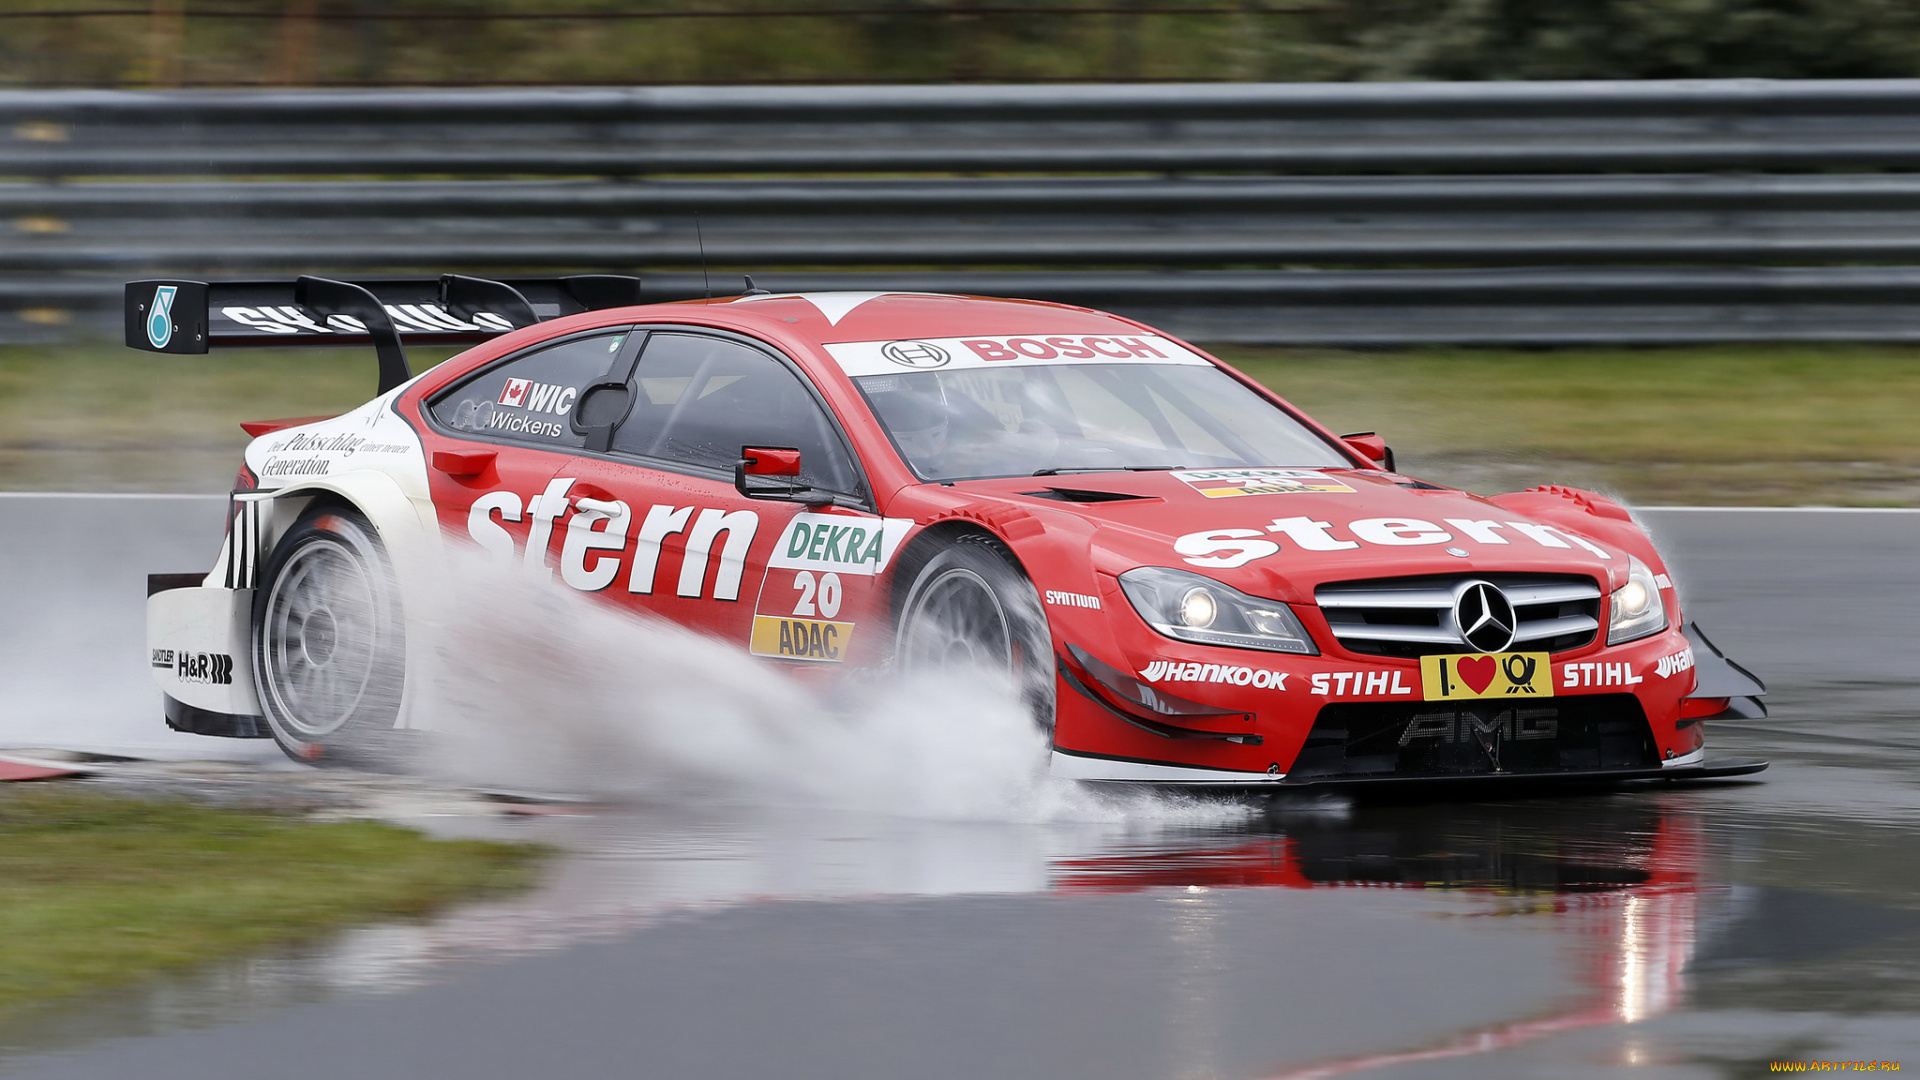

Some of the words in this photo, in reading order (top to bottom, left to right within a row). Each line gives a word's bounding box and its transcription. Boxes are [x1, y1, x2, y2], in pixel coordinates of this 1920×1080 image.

[960, 337, 1169, 362] BOSCH
[527, 382, 577, 415] WIC
[490, 411, 563, 438] Wickens
[283, 433, 366, 457] Pulsschlag
[261, 454, 330, 477] Generation.
[468, 478, 760, 602] stern
[787, 522, 884, 564] DEKRA
[1174, 516, 1612, 569] stern
[792, 571, 842, 619] 20
[1045, 590, 1101, 610] SYNTIUM
[779, 621, 838, 659] ADAC
[178, 651, 210, 682] H&R
[1564, 662, 1643, 688] STIHL
[1310, 670, 1411, 696] STIHL
[1398, 708, 1559, 746] AMG
